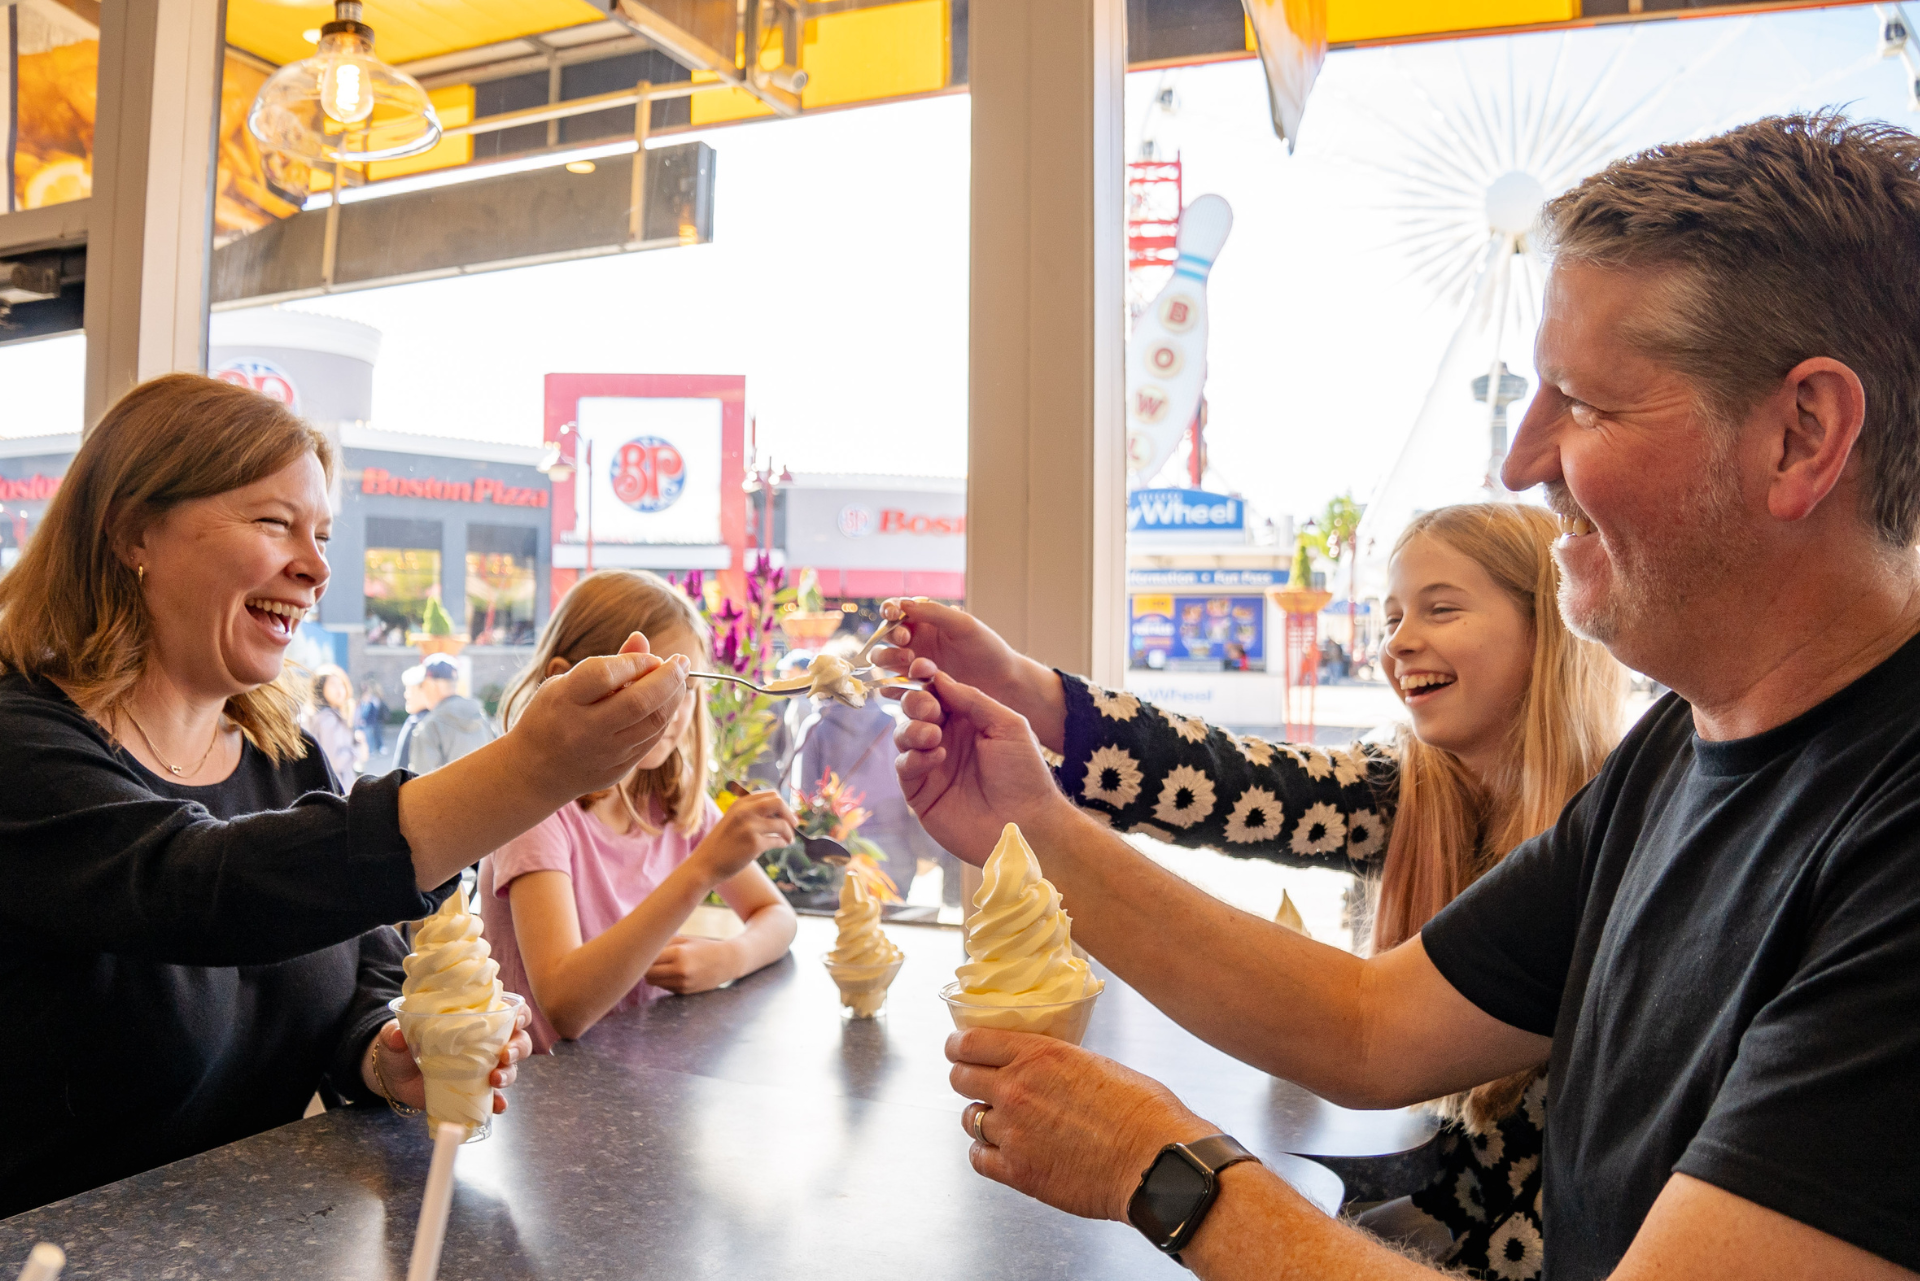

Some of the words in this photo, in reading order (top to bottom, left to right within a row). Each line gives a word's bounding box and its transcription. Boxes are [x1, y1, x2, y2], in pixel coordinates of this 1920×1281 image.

[362, 466, 472, 502] Boston
[472, 476, 549, 508] Pizza
[612, 443, 683, 503] BP
